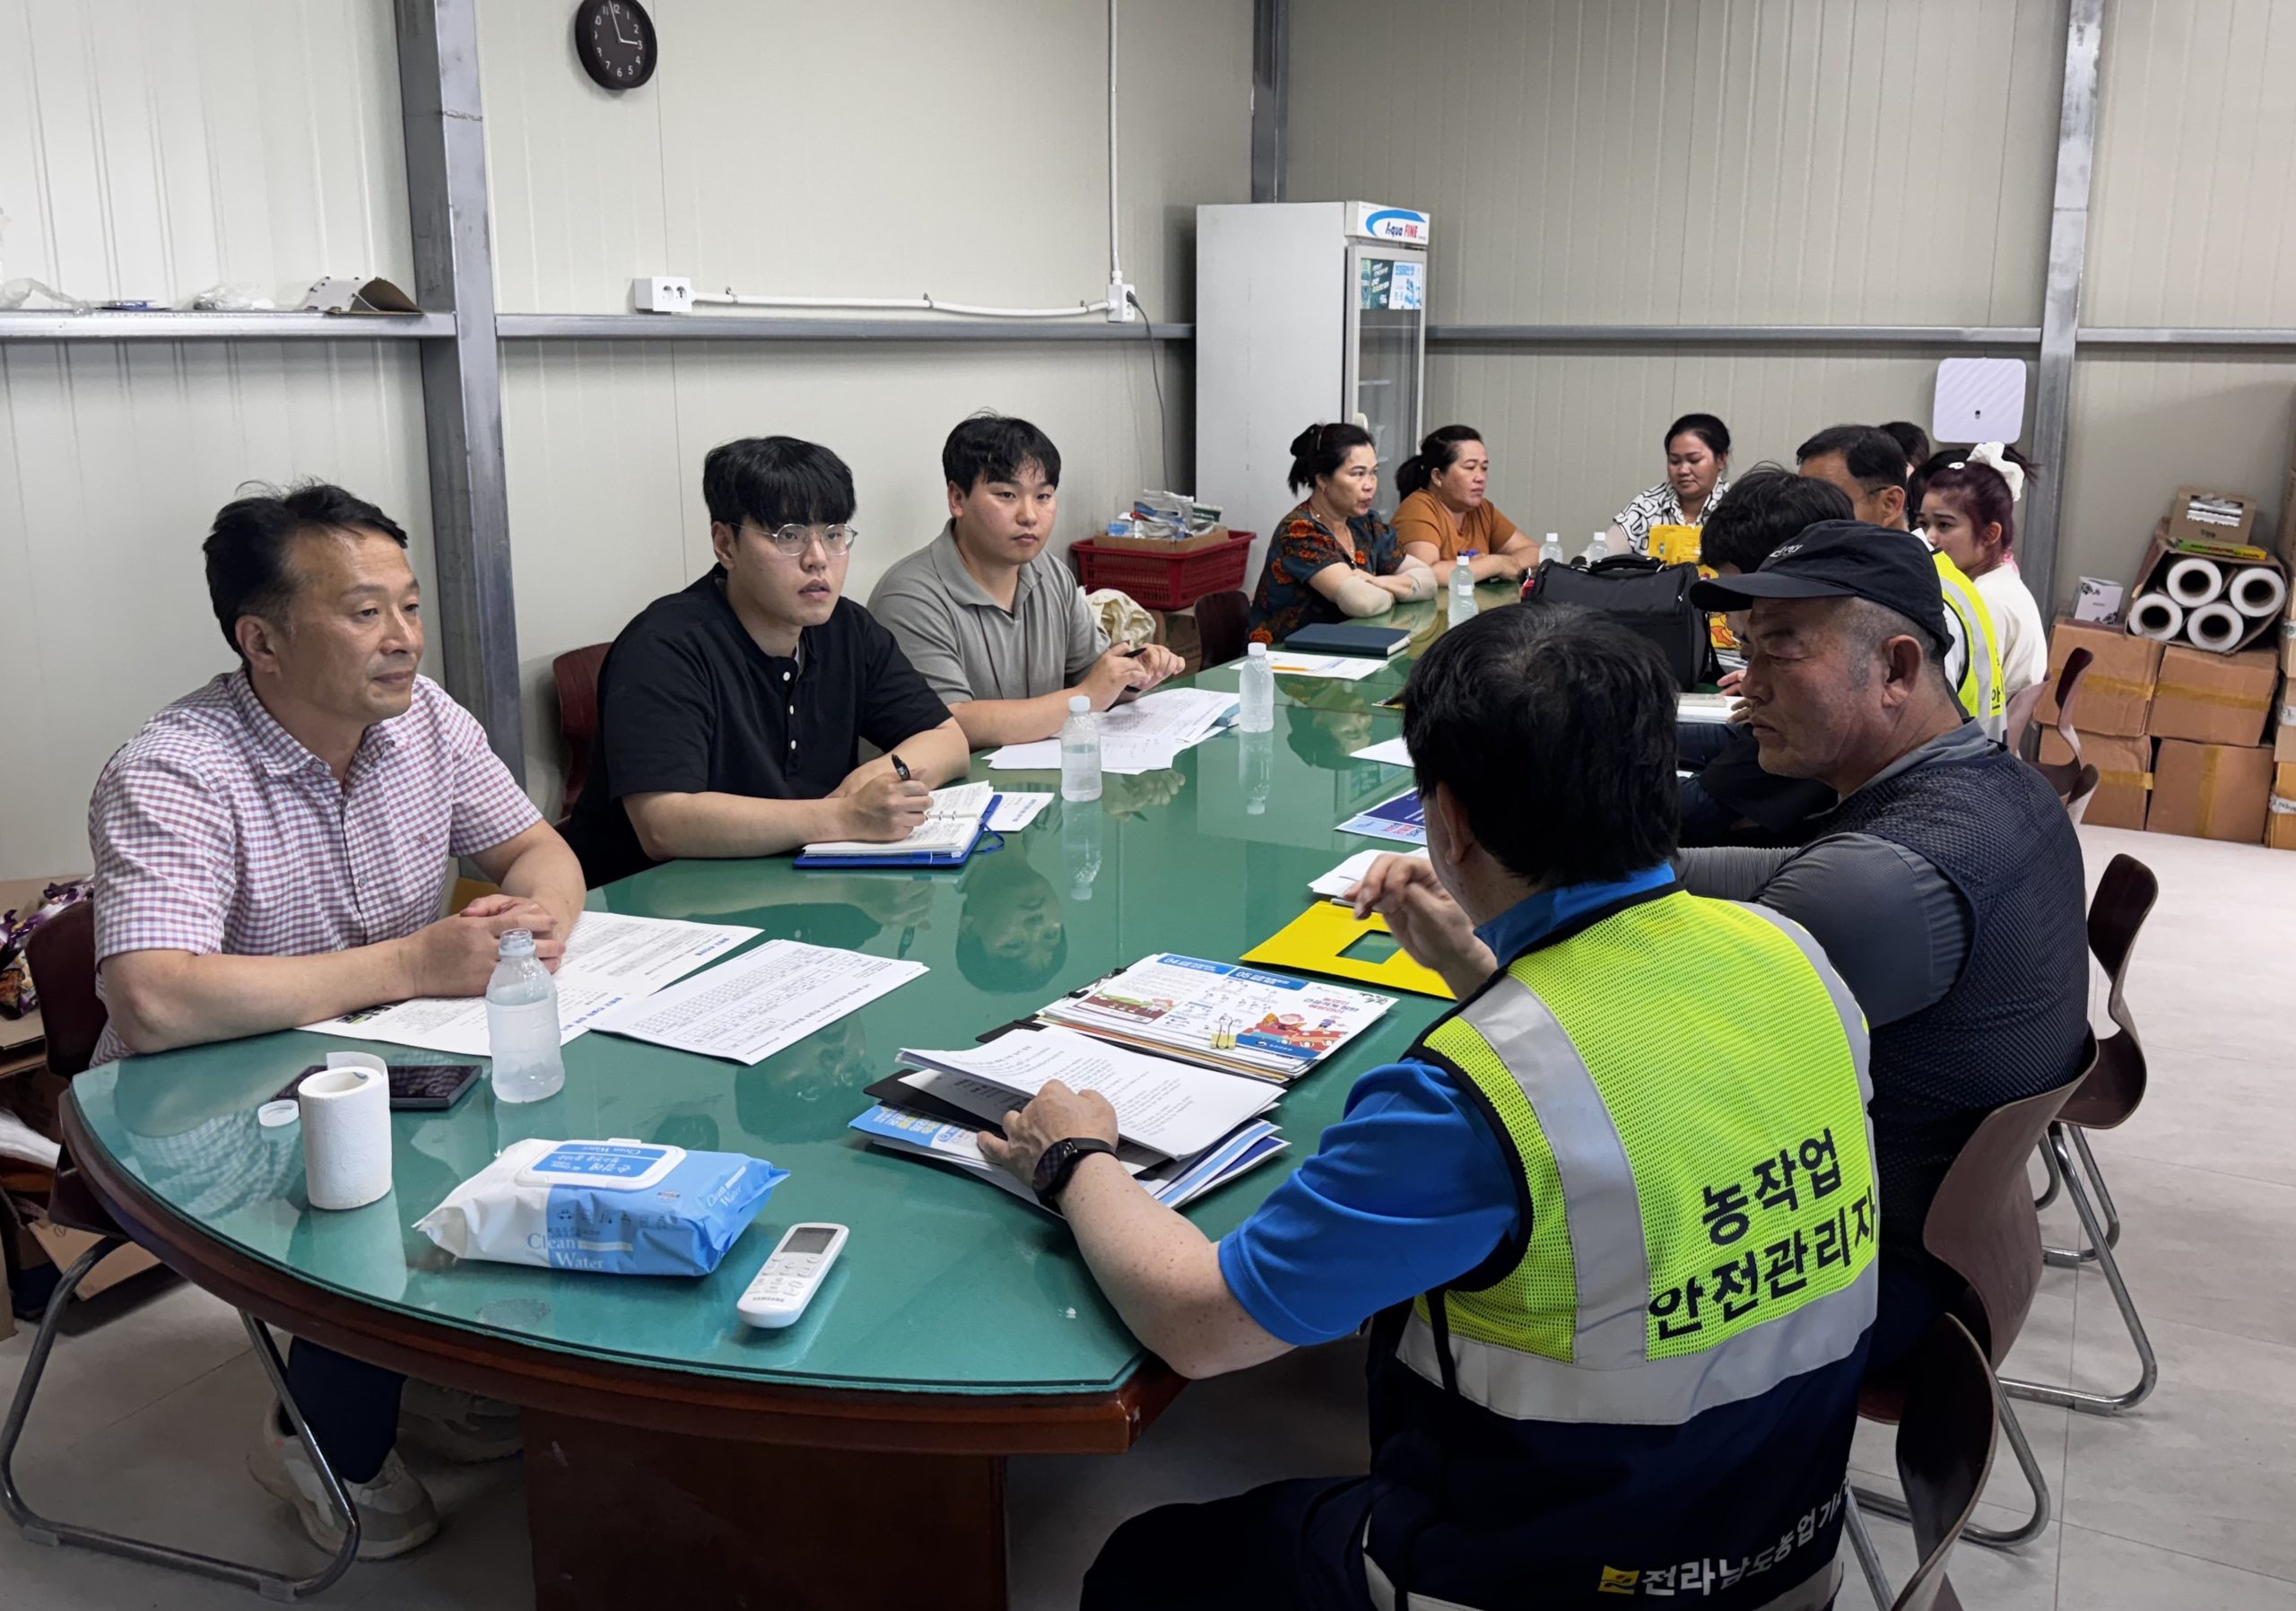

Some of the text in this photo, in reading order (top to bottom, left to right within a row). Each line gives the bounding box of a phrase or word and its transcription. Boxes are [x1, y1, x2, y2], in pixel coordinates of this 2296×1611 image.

[633, 23, 639, 34] 2
[638, 40, 643, 49] 3
[605, 61, 611, 70] 7
[635, 56, 640, 65] 4
[617, 67, 622, 77] 6
[628, 65, 633, 74] 5
[1702, 1128, 1841, 1246] 농작업
[527, 1232, 577, 1250] Clean
[556, 1251, 604, 1269] Water
[1648, 1185, 1875, 1340] 안전관리자
